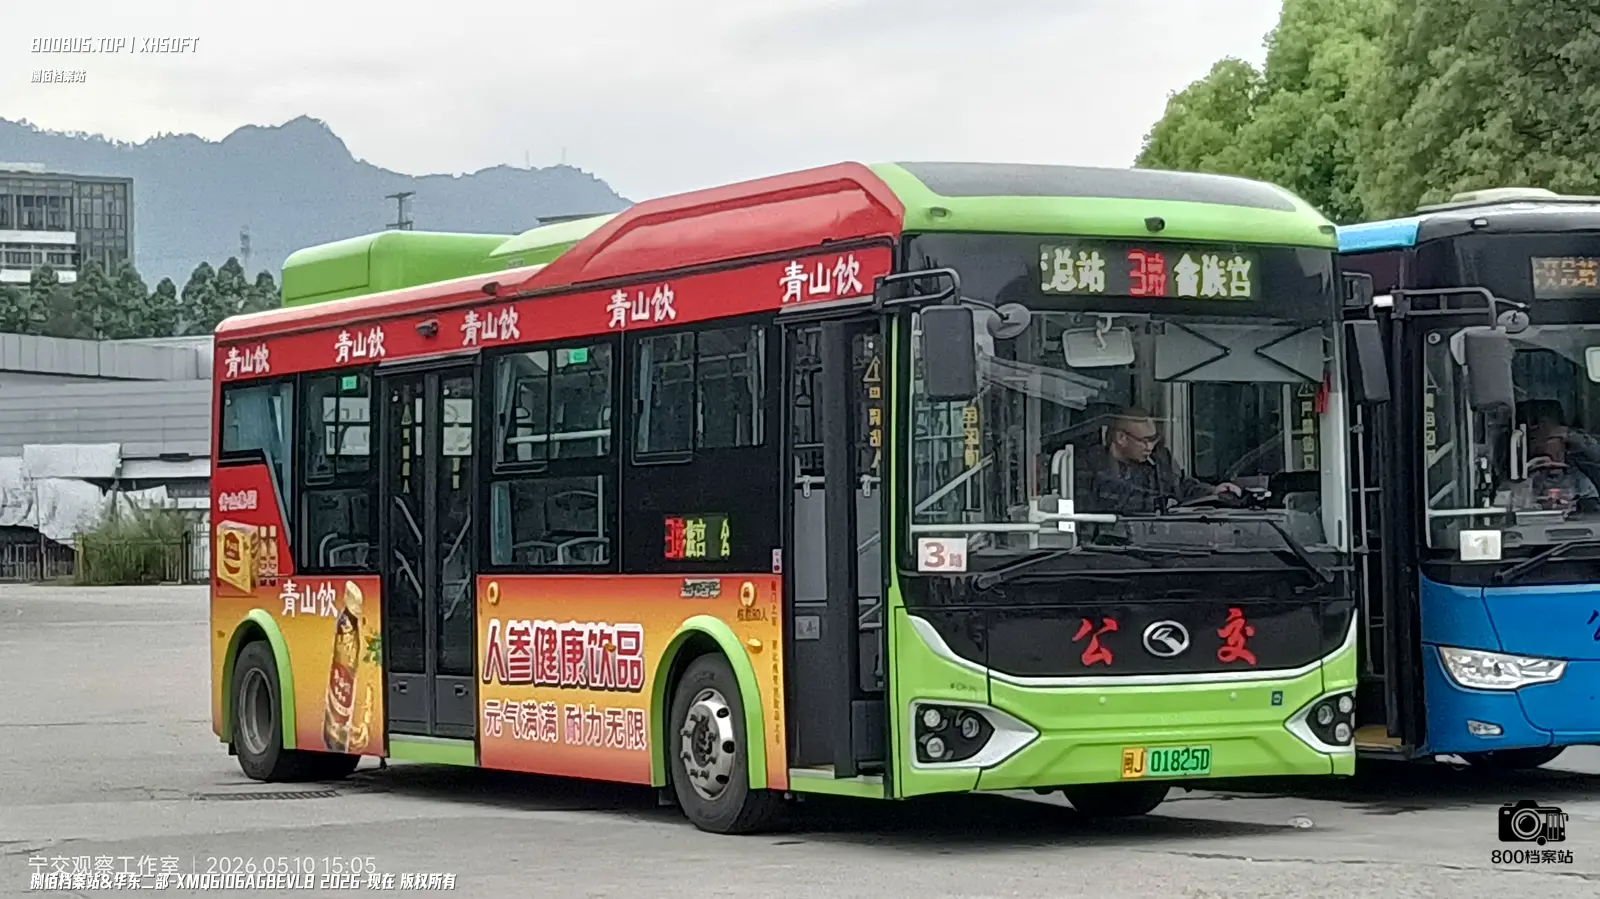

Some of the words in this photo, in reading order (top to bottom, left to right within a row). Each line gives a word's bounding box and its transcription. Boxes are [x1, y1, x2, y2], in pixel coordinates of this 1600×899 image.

[778, 254, 863, 304] 青山饮
[1040, 248, 1105, 293] 总站
[460, 307, 520, 346] 青山饮
[606, 282, 677, 328] 青山饮
[224, 342, 270, 378] 青山饮
[334, 326, 386, 363] 青山饮
[279, 579, 339, 618] 青山饮
[482, 618, 646, 691] 人参健康饮品
[1072, 616, 1119, 667] 公
[1215, 607, 1257, 667] 交
[484, 699, 560, 743] 元气满满
[564, 704, 648, 751] 耐力无限
[1150, 747, 1211, 773] 01825D
